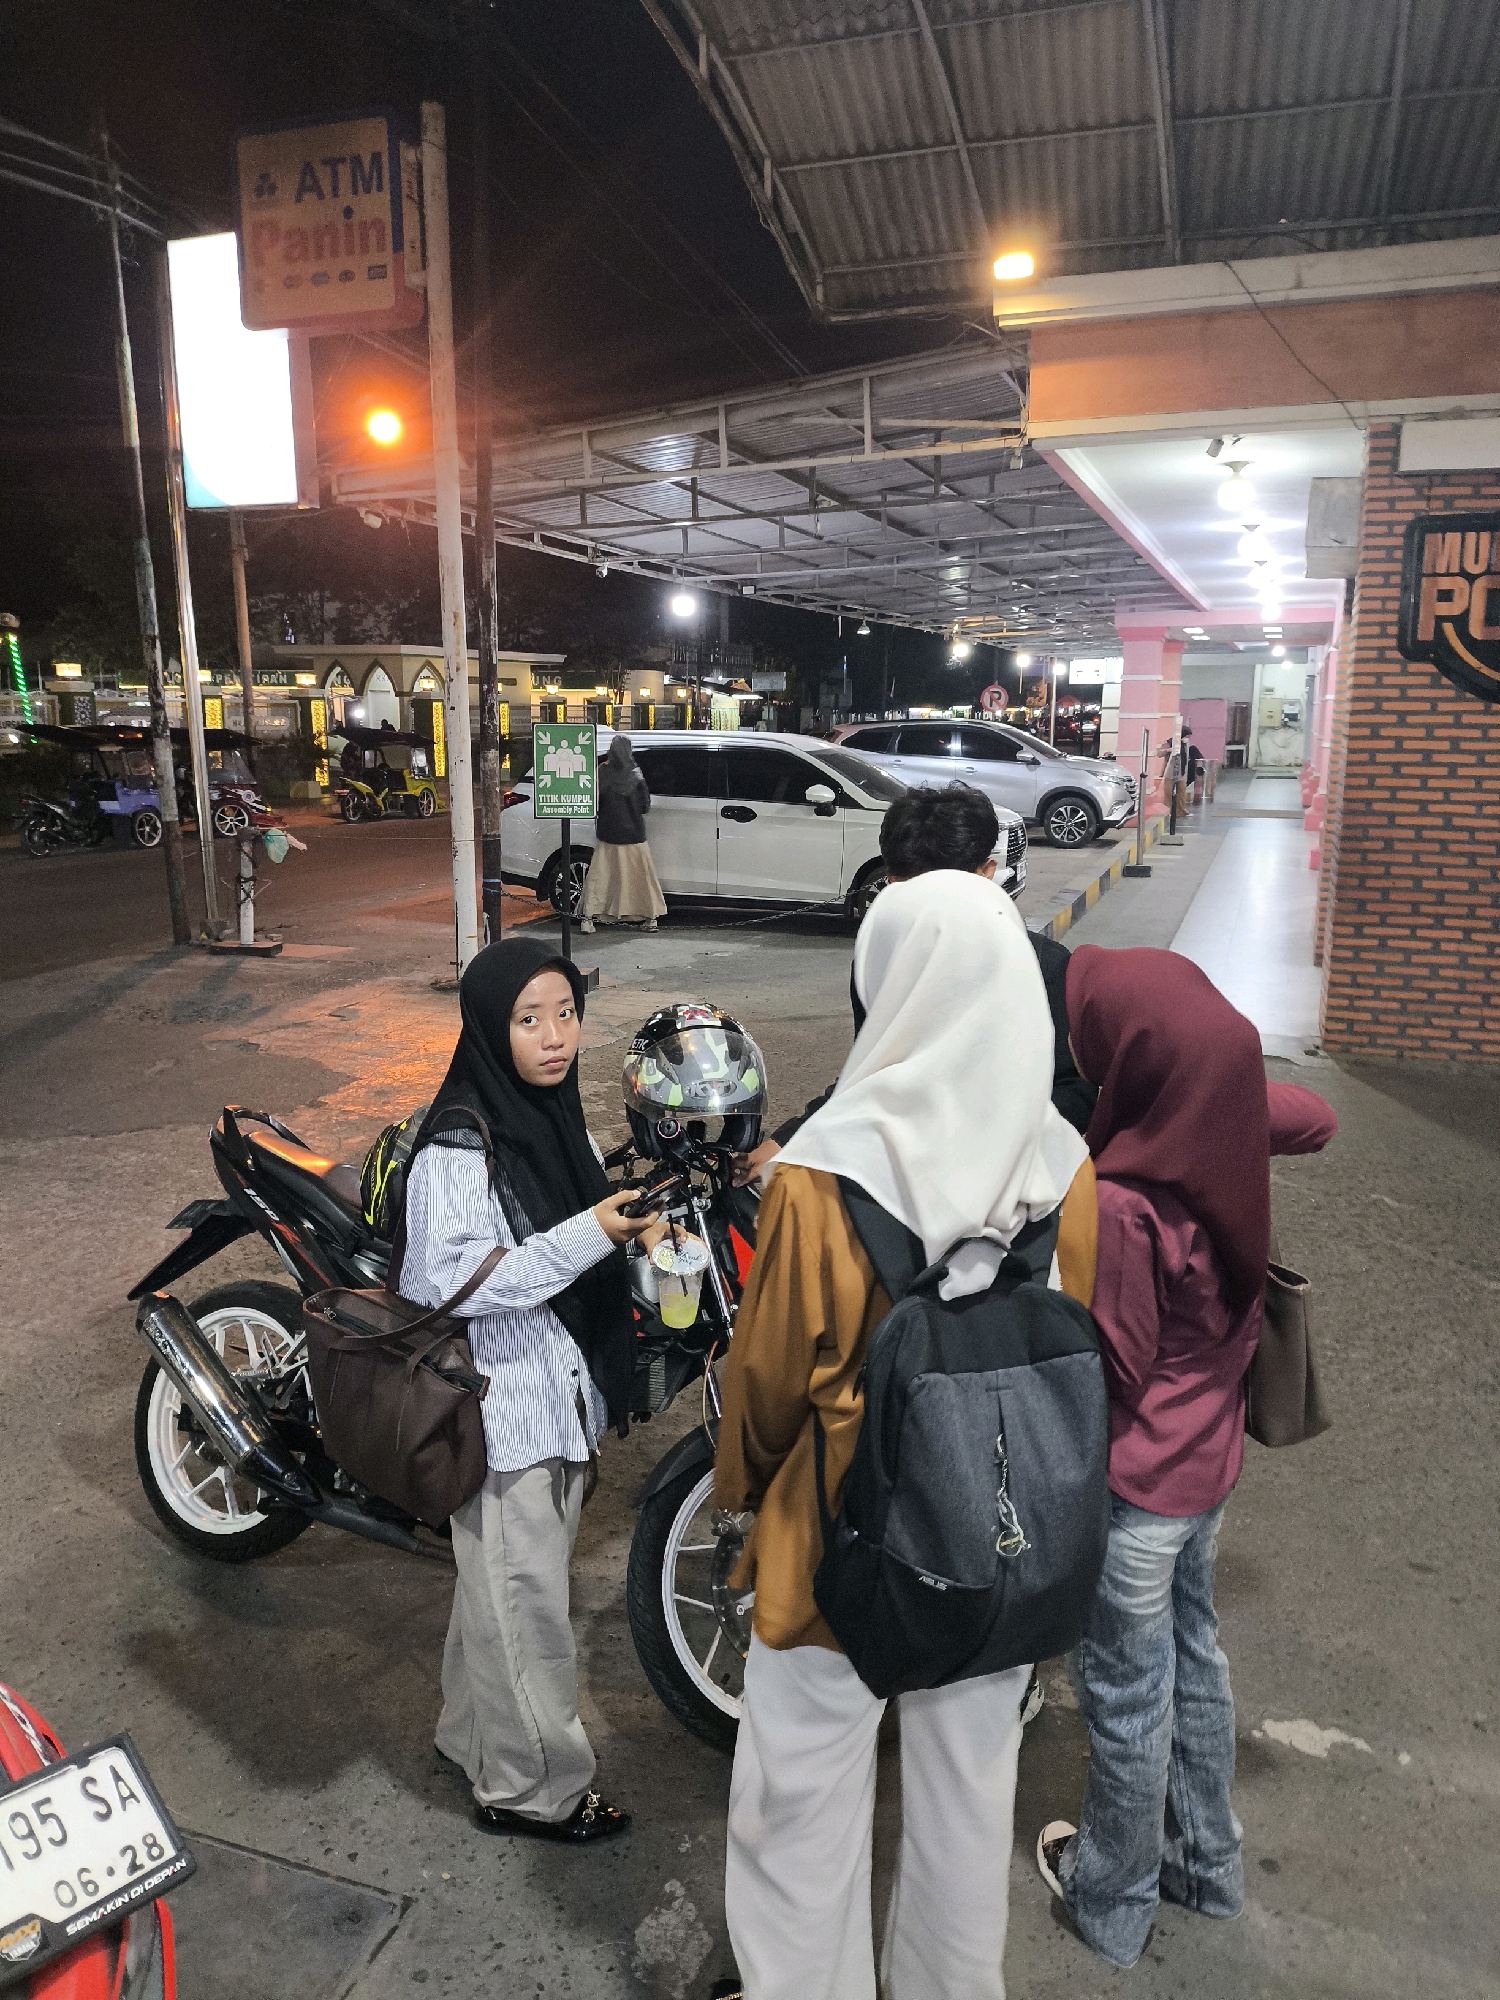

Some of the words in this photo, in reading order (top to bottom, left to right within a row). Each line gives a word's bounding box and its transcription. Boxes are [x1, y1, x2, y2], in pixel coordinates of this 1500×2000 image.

[295, 152, 384, 203] ATM
[252, 205, 386, 268] Panin
[1422, 531, 1500, 574] MU
[539, 794, 559, 803] TITIK
[560, 794, 592, 803] KUMPUL
[542, 805, 572, 814] Assembly
[573, 805, 590, 814] Point
[919, 1575, 947, 1590] ASUS
[80, 1764, 141, 1823] SA
[65, 1892, 130, 1936] SEMAKIN
[144, 1858, 187, 1891] DEPAN
